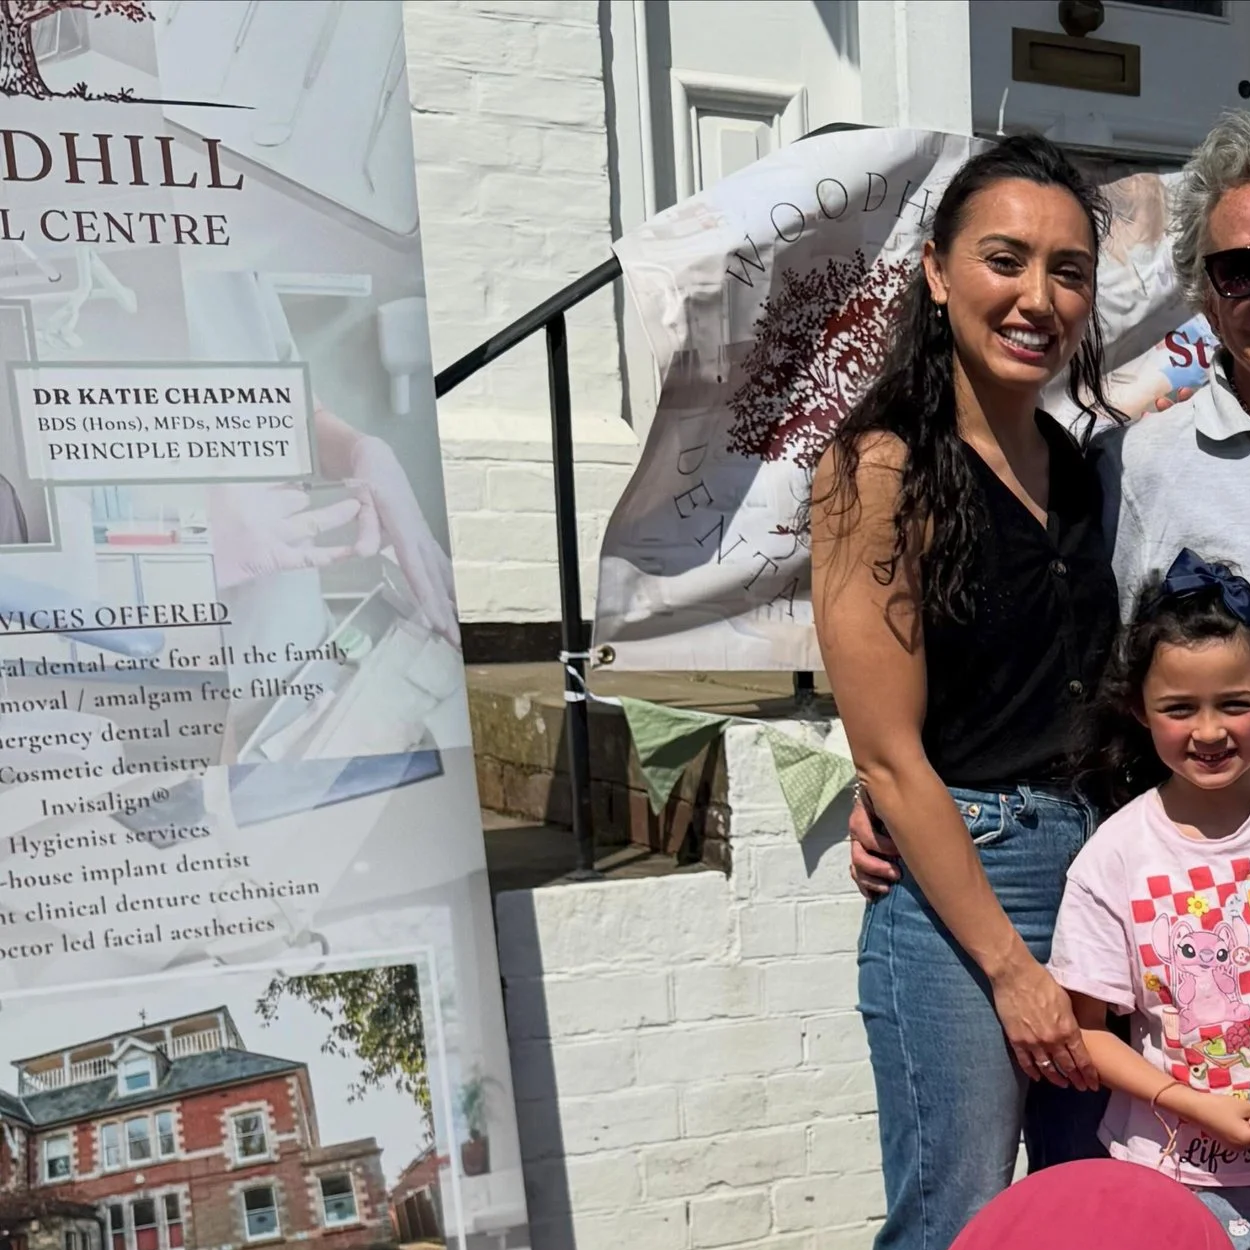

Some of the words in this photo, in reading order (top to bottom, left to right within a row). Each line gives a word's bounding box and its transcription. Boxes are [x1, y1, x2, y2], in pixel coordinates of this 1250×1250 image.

[40, 209, 230, 246] CENTRE
[726, 170, 934, 289] WOODH
[33, 387, 72, 405] DR
[78, 387, 159, 405] KATIE
[164, 387, 292, 405] CHAPMAN
[38, 417, 77, 432] BDS
[82, 415, 150, 434] (Hons),
[155, 416, 211, 433] MFDs,
[215, 415, 251, 430] MSc
[256, 414, 294, 430] PDC
[49, 441, 181, 461] PRINCIPLE
[188, 440, 290, 458] DENTIST
[95, 602, 229, 627] OFFERED
[35, 654, 105, 676] dental
[115, 655, 160, 672] care
[169, 648, 200, 668] for
[208, 647, 234, 665] all
[244, 645, 277, 664] the
[286, 641, 349, 665] family
[95, 686, 192, 710] amalgam
[201, 681, 243, 701] free
[251, 678, 324, 701] fillings
[101, 719, 171, 742] dental
[178, 720, 225, 738] care
[0, 761, 104, 785] Cosmetic
[111, 754, 212, 778] dentistry
[9, 830, 118, 857] Hygienist
[125, 824, 211, 843] services
[81, 858, 168, 885] implant
[175, 852, 252, 874] dentist
[25, 896, 107, 923] clinical
[115, 893, 201, 914] denture
[208, 880, 320, 904] technician
[62, 930, 96, 953] led
[103, 923, 163, 950] facial
[170, 917, 276, 943] aesthetics
